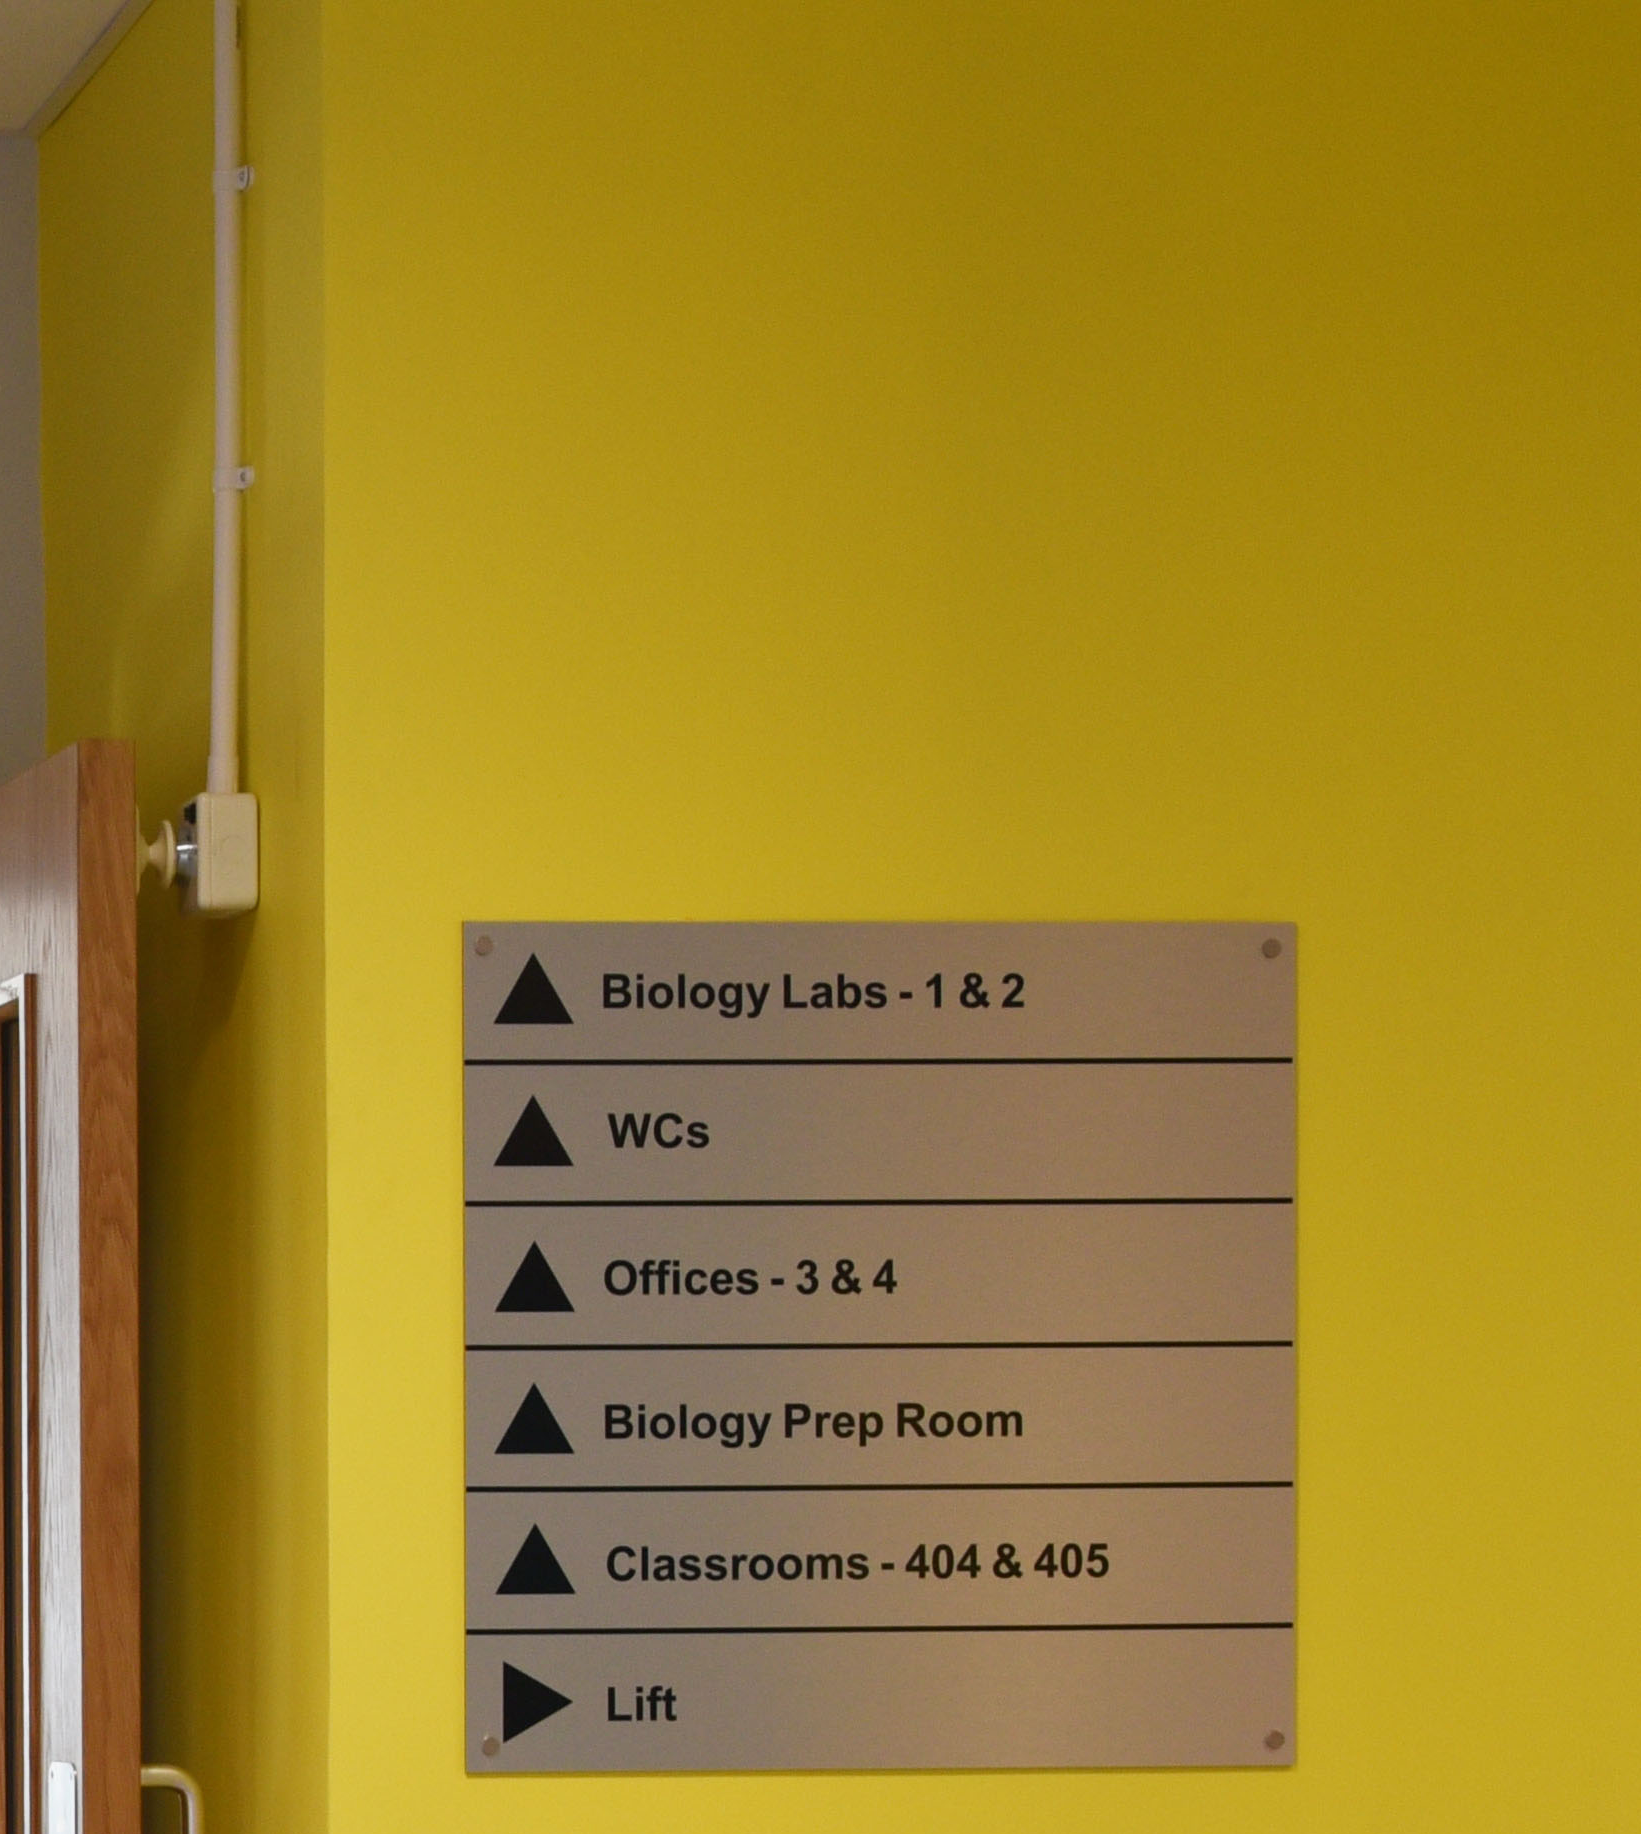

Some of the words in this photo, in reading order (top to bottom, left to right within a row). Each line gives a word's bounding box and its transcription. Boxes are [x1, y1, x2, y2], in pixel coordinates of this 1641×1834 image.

[602, 973, 771, 1019] Biology
[783, 973, 888, 1010] Labs
[925, 972, 943, 1009] 1
[959, 972, 991, 1009] &
[1001, 972, 1026, 1009] 2
[607, 1112, 710, 1149] WCs
[603, 1259, 760, 1297] Offices
[796, 1259, 819, 1295] 3
[831, 1258, 862, 1295] &
[872, 1258, 898, 1294] 4
[604, 1403, 772, 1449] Biology
[784, 1403, 885, 1447] Prep
[897, 1402, 1024, 1438] Room
[606, 1545, 870, 1582] Classrooms
[905, 1543, 982, 1580] 404
[992, 1543, 1023, 1579] &
[1033, 1543, 1110, 1579] 405
[607, 1685, 678, 1722] Lift
